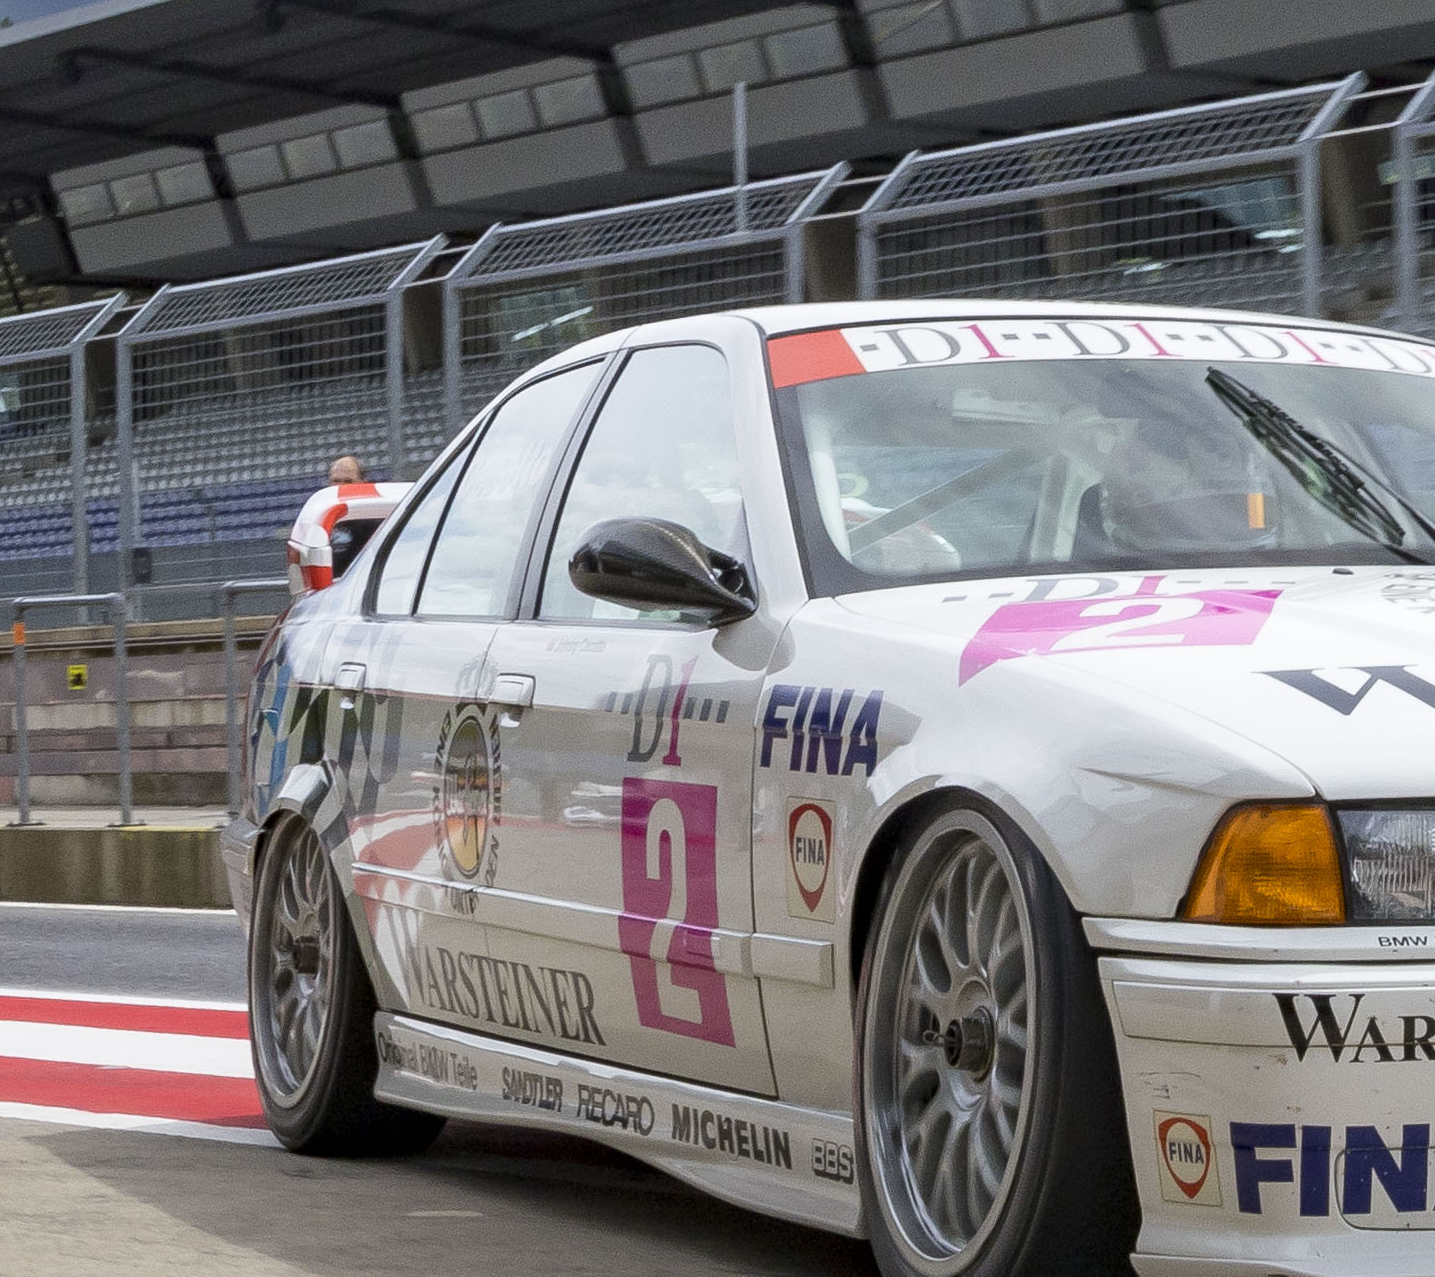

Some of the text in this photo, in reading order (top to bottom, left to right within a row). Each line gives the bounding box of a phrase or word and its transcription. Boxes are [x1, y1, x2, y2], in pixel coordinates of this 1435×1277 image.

[1049, 597, 1206, 652] 2
[759, 684, 884, 777] FINA
[795, 836, 825, 867] FINA
[645, 797, 703, 1024] 2
[1377, 935, 1428, 948] BMW
[501, 1066, 563, 1112] SANDTLER
[576, 1084, 654, 1136] RECARO
[671, 1104, 792, 1169] MICHELIN
[811, 1138, 854, 1183] BBS
[1168, 1141, 1205, 1166] FINA
